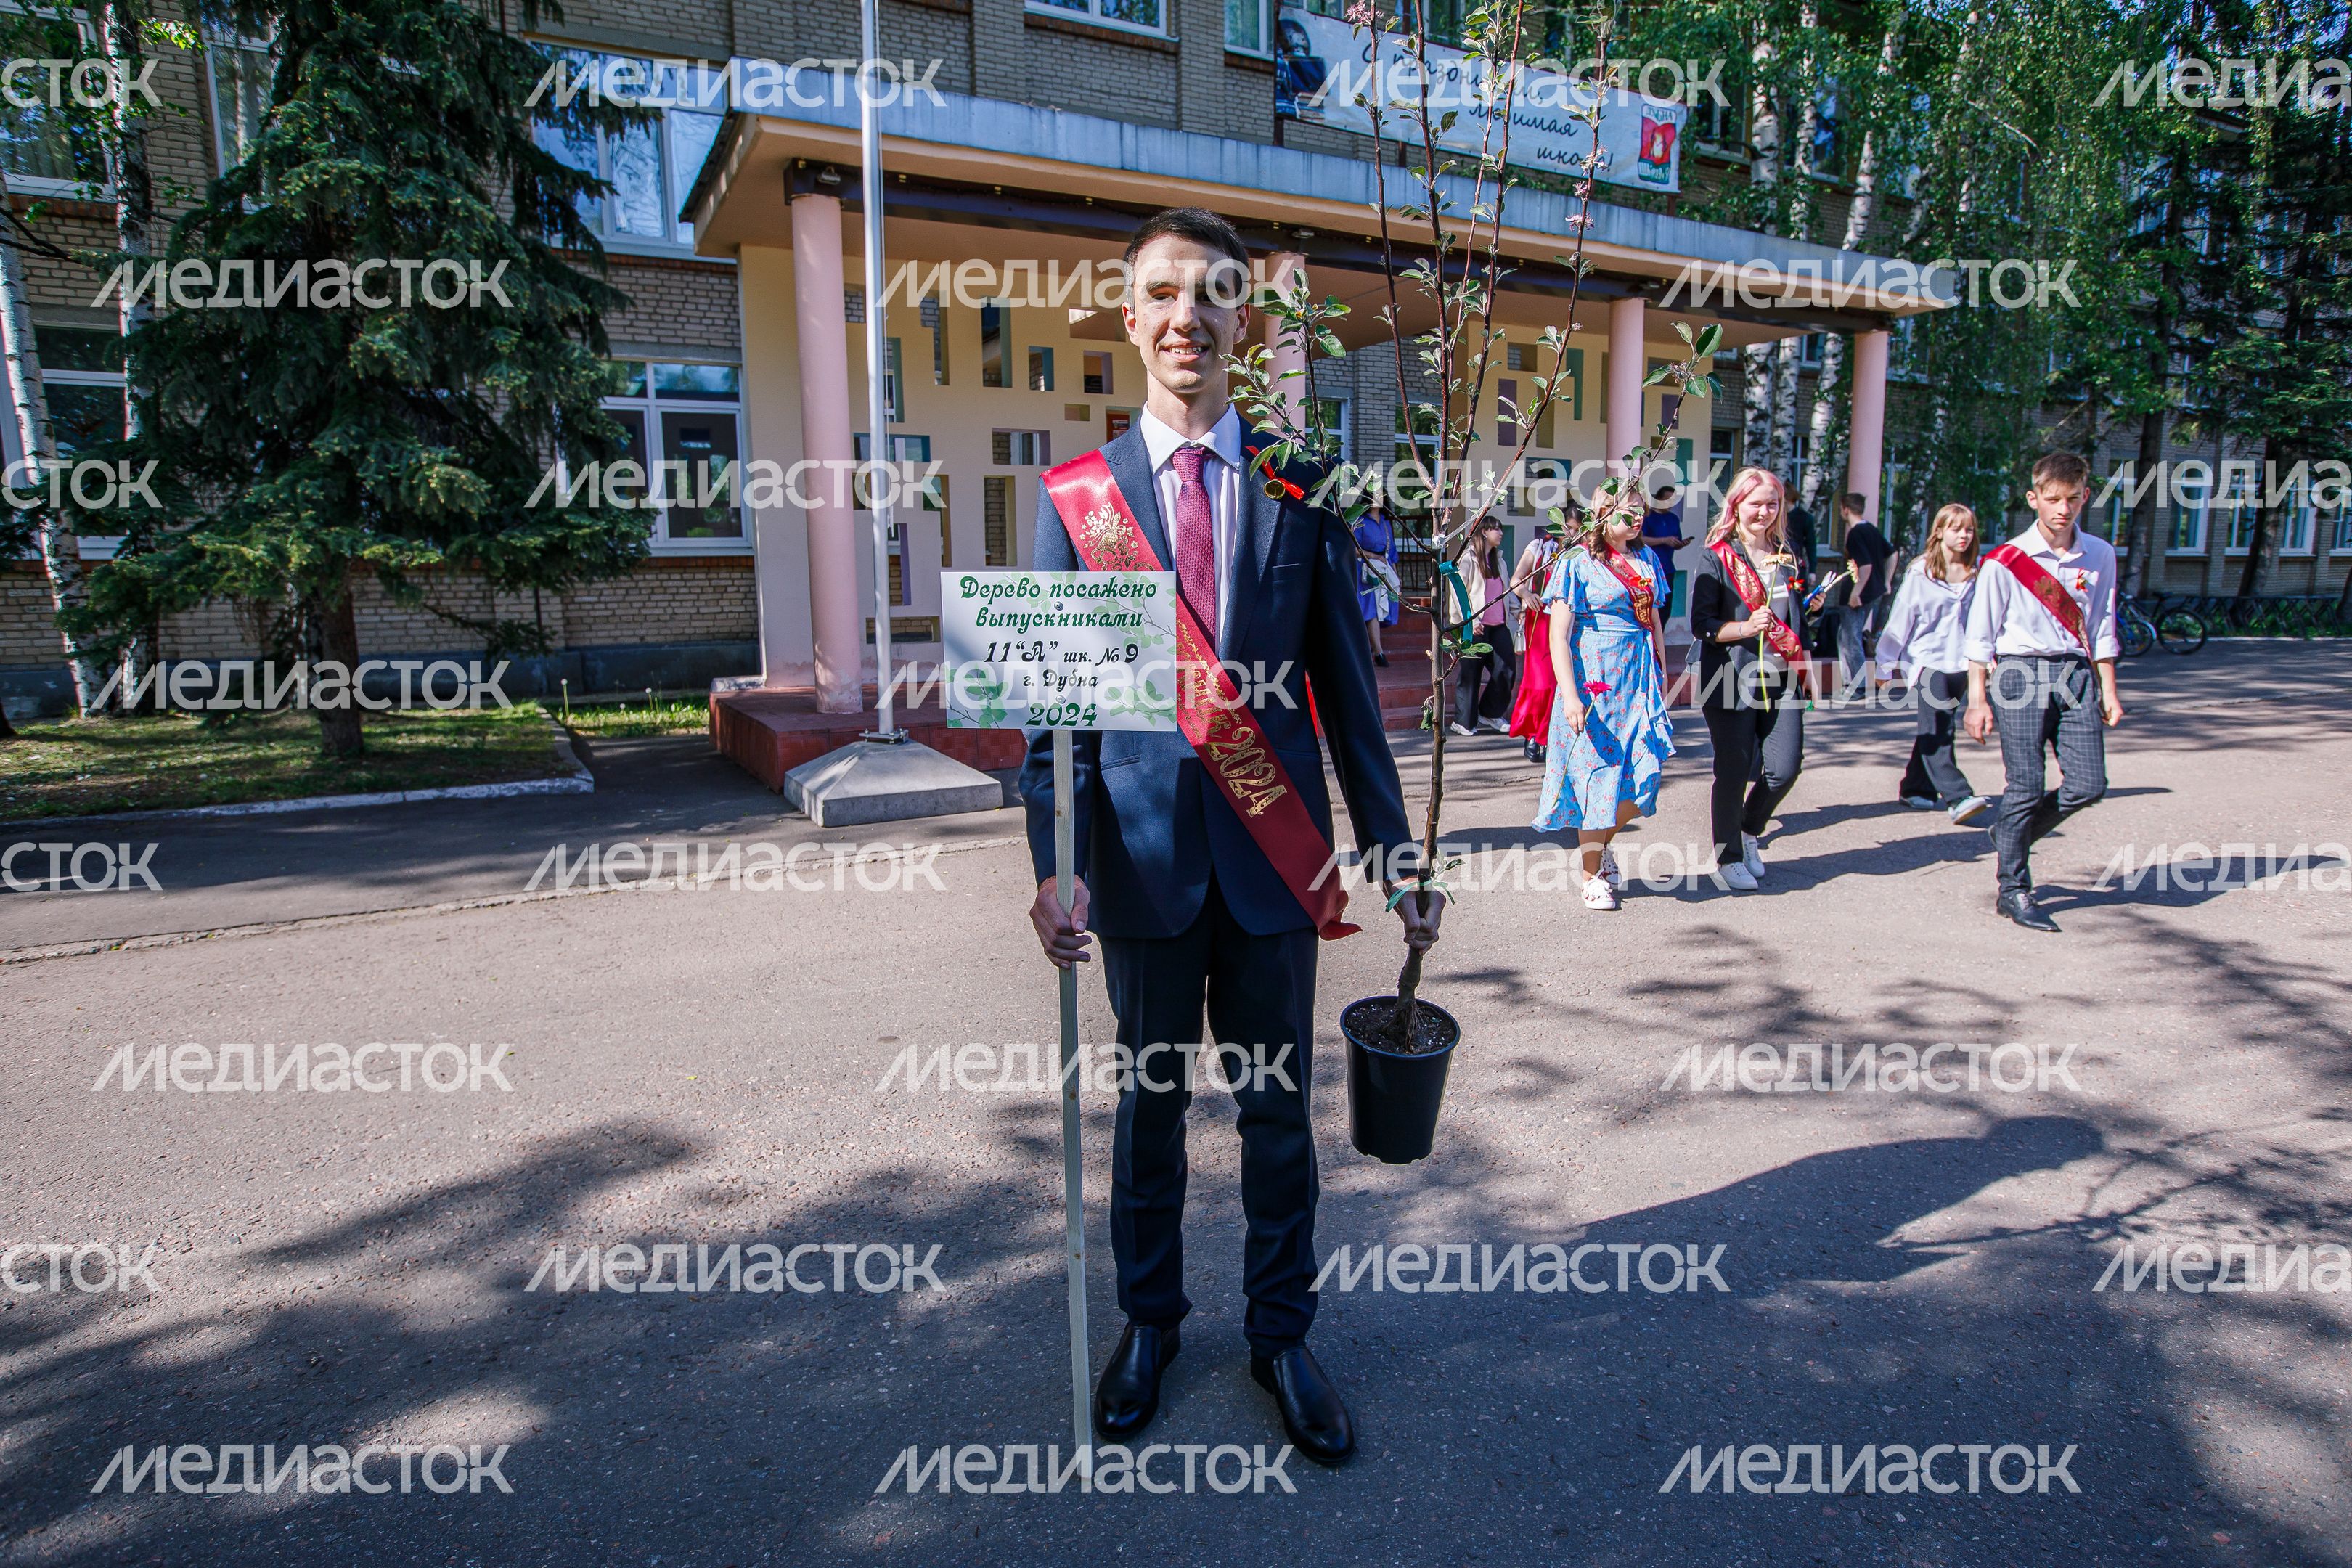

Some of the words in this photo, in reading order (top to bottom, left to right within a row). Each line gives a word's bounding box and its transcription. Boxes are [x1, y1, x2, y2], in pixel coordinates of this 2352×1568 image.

[1537, 145, 1614, 172] шкоа!
[960, 576, 1041, 605] Дерево
[1049, 576, 1157, 598] посажено
[976, 606, 1143, 634] выпускниками
[1063, 651, 1092, 663] шк.
[1042, 669, 1098, 693] Дубна
[1025, 703, 1098, 727] 2024
[1203, 727, 1288, 818] 2024
